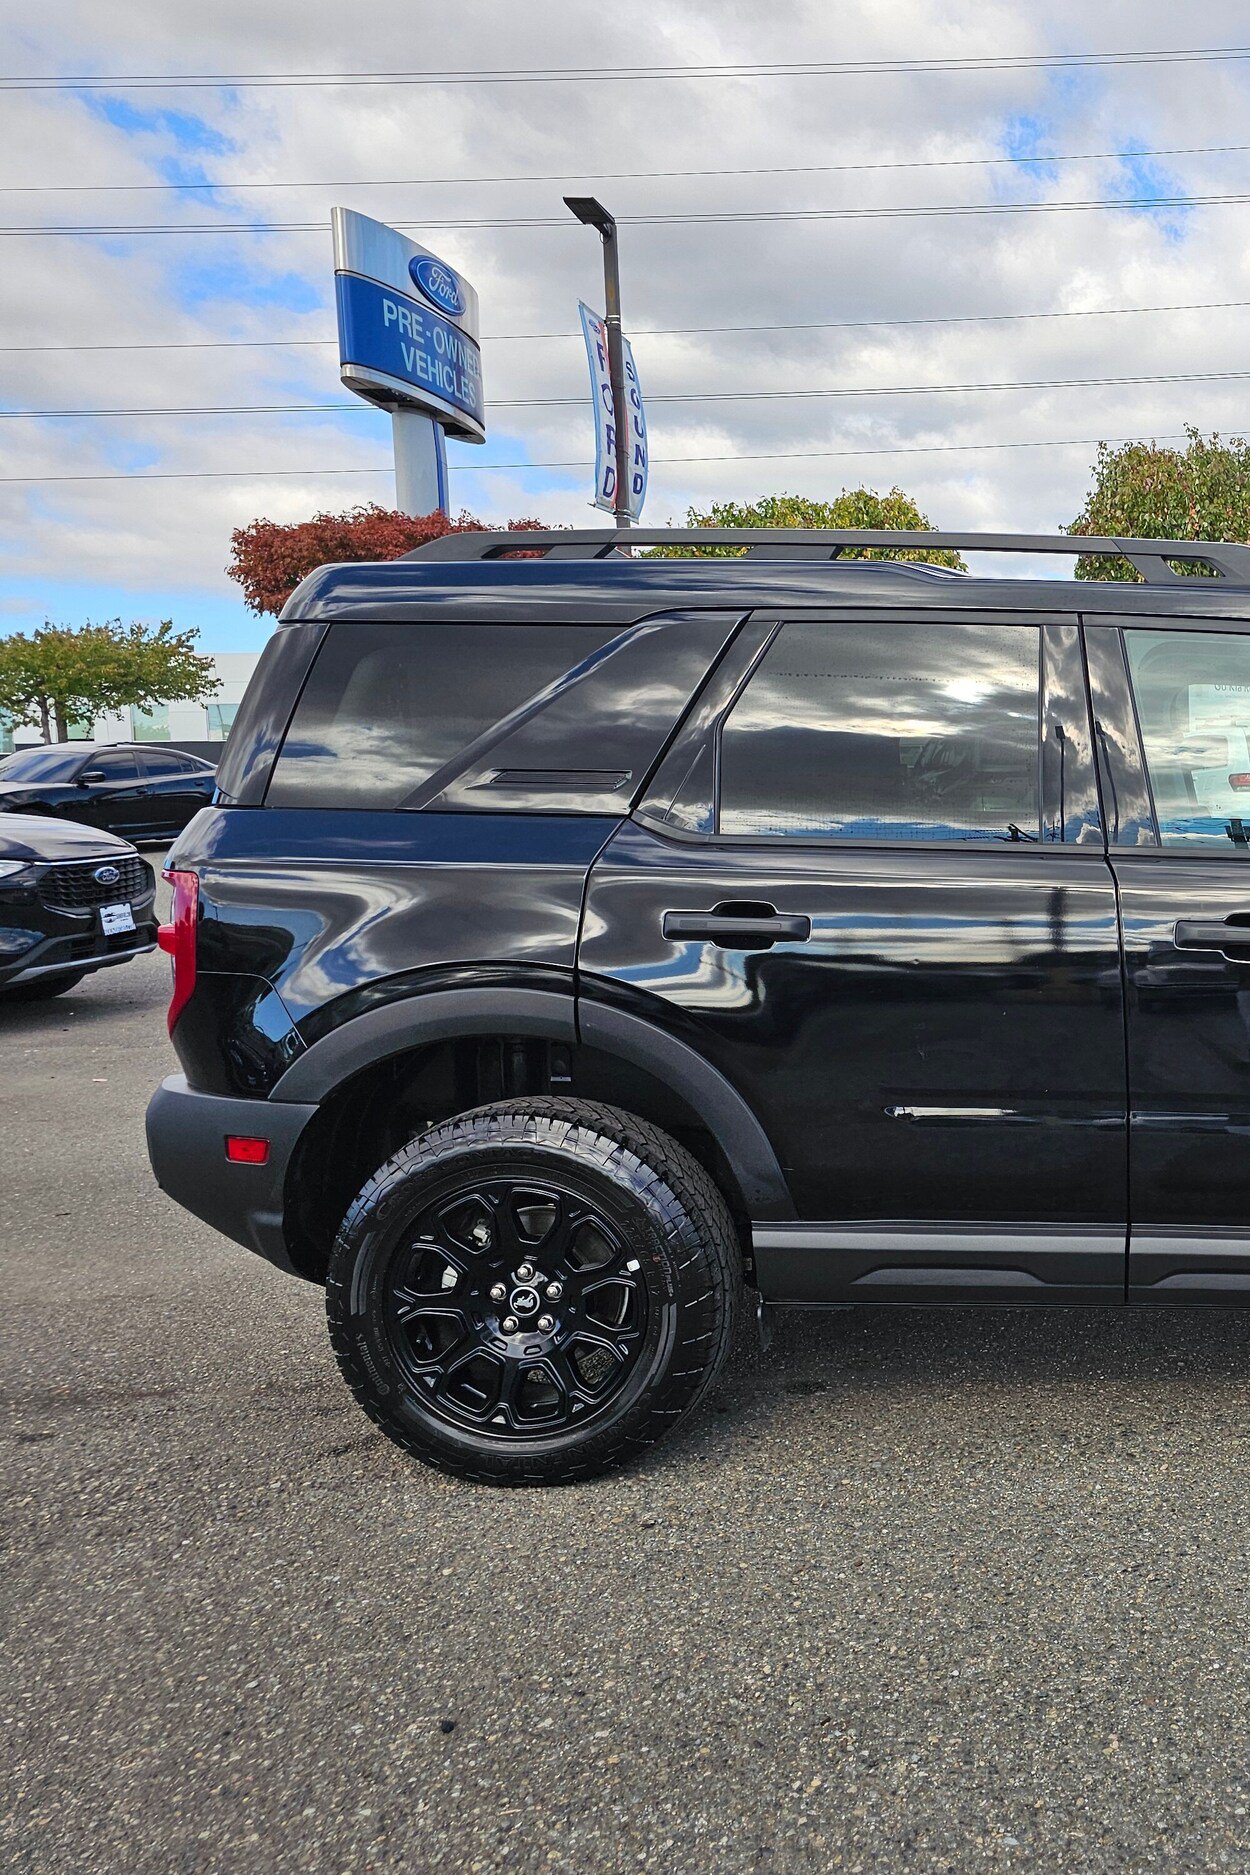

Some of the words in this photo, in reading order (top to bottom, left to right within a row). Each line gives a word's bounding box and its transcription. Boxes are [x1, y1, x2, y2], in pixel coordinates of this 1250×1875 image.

[428, 266, 459, 306] Ford
[401, 342, 477, 408] VEHICLES
[626, 362, 646, 495] SOUND
